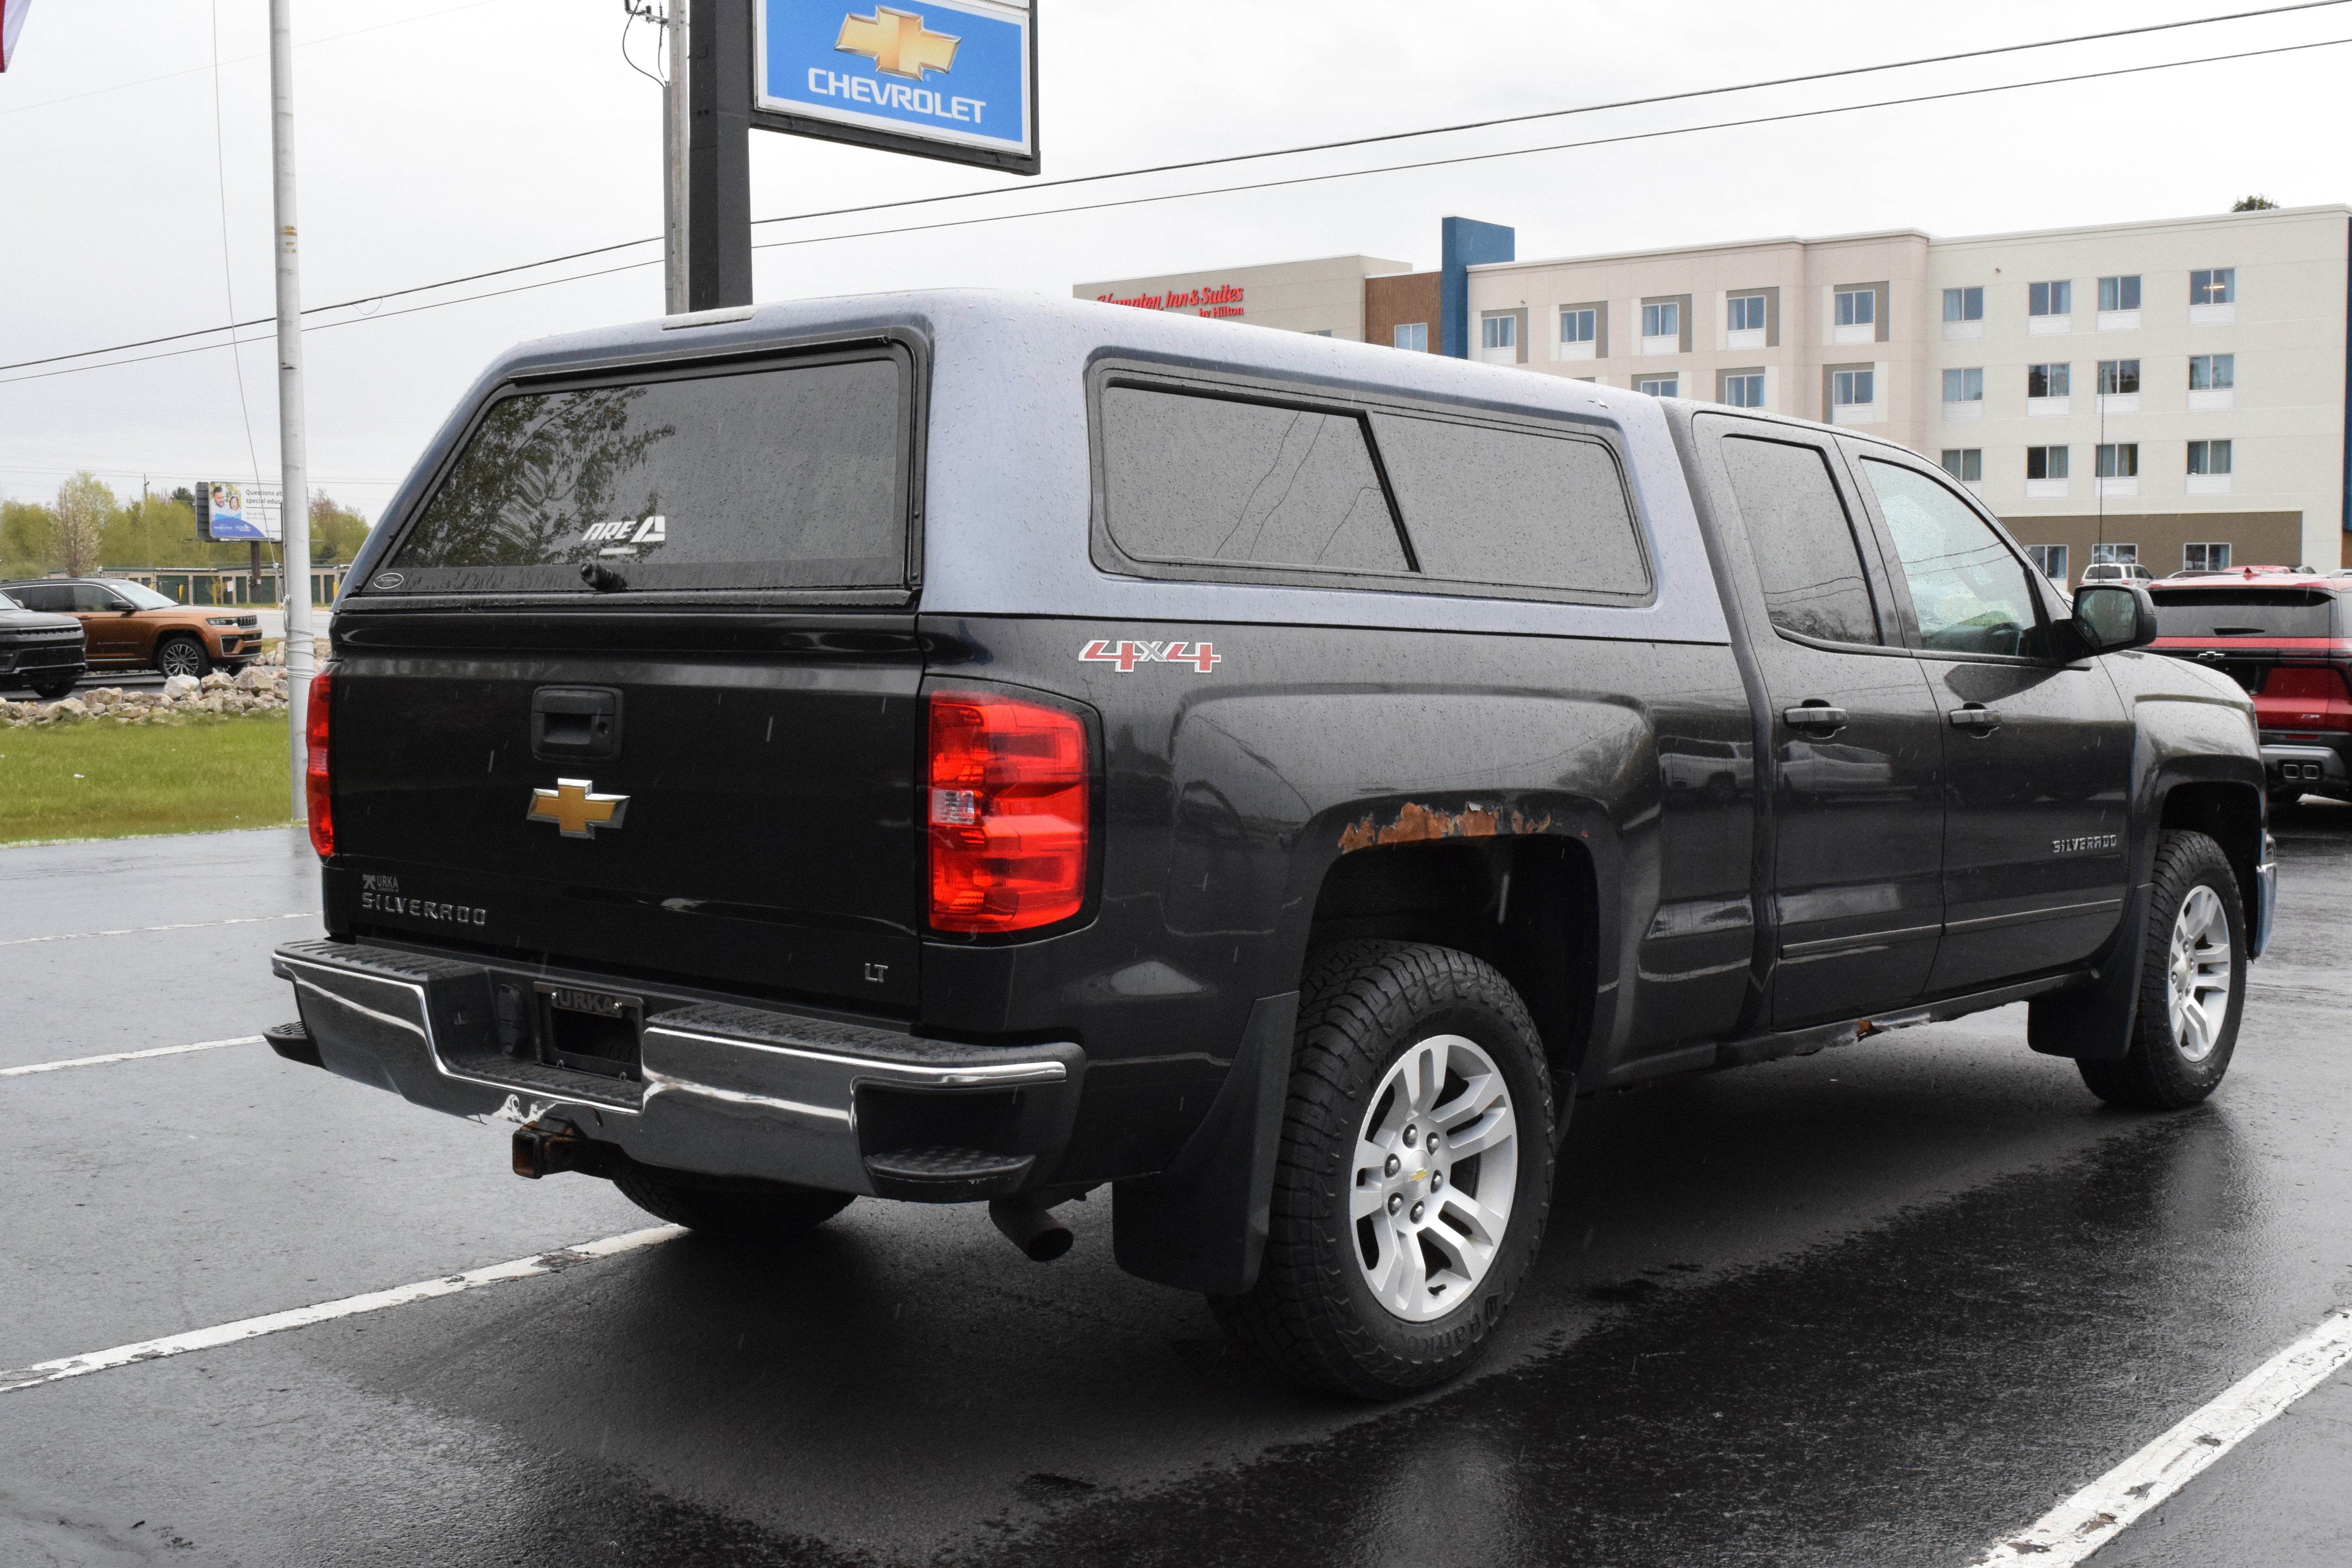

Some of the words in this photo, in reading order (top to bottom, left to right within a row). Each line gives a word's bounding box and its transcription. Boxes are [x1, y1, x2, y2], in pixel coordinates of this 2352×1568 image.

[808, 68, 986, 123] CHEVROLET
[1165, 290, 1188, 308] Inn
[1189, 289, 1199, 305] &
[1200, 285, 1243, 305] Suites
[1212, 306, 1243, 318] Hilton
[2052, 835, 2117, 853] SILVERADO
[362, 892, 487, 926] SILVERADO
[865, 963, 888, 983] LT
